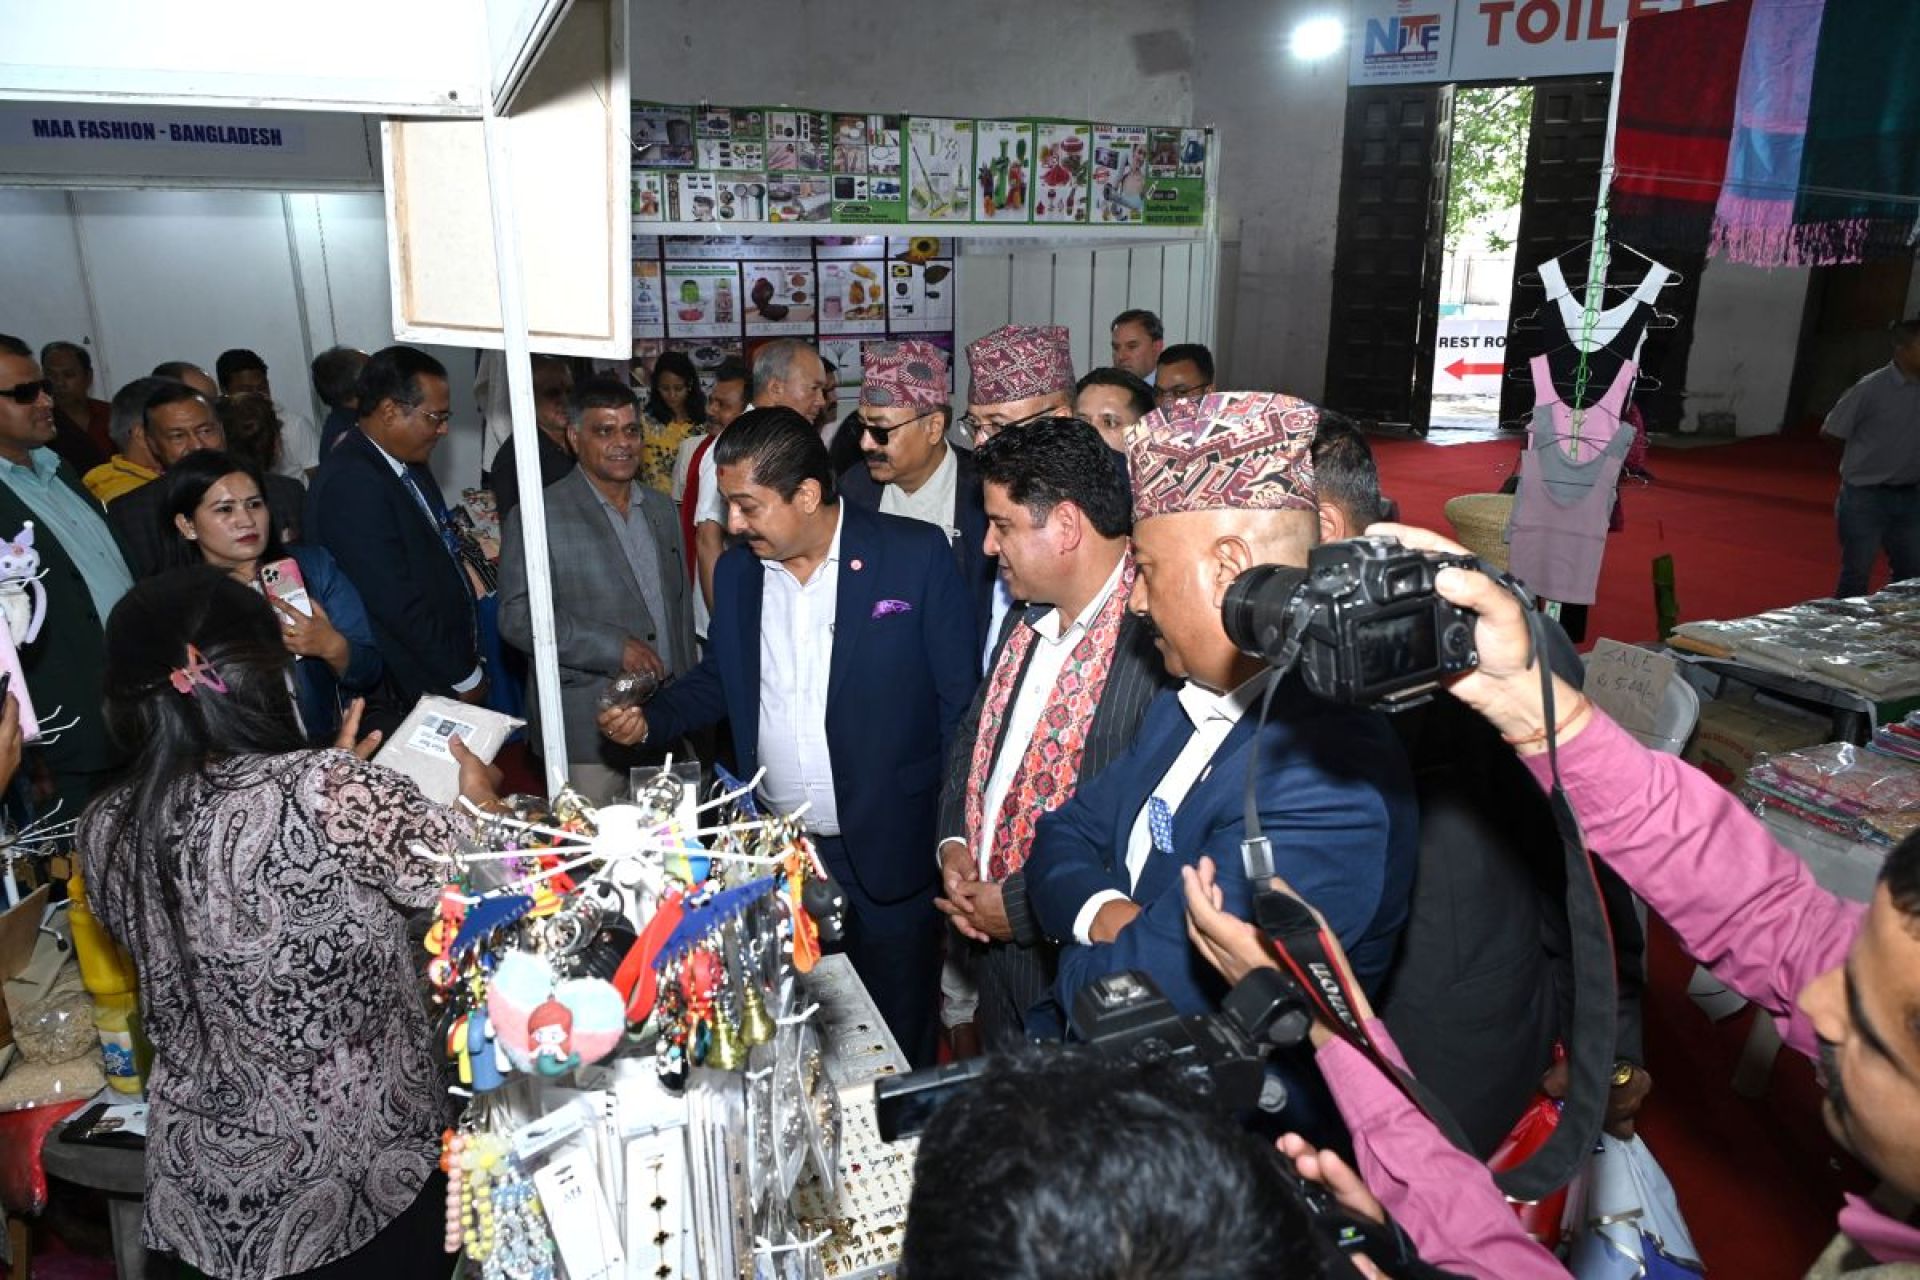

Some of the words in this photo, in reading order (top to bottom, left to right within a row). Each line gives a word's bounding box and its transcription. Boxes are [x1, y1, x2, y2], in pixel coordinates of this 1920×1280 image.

[1479, 0, 1696, 46] TOILE
[33, 119, 74, 138] MAA
[79, 120, 155, 140] FASHION
[170, 124, 282, 146] BANGLADESH
[1439, 336, 1480, 348] REST
